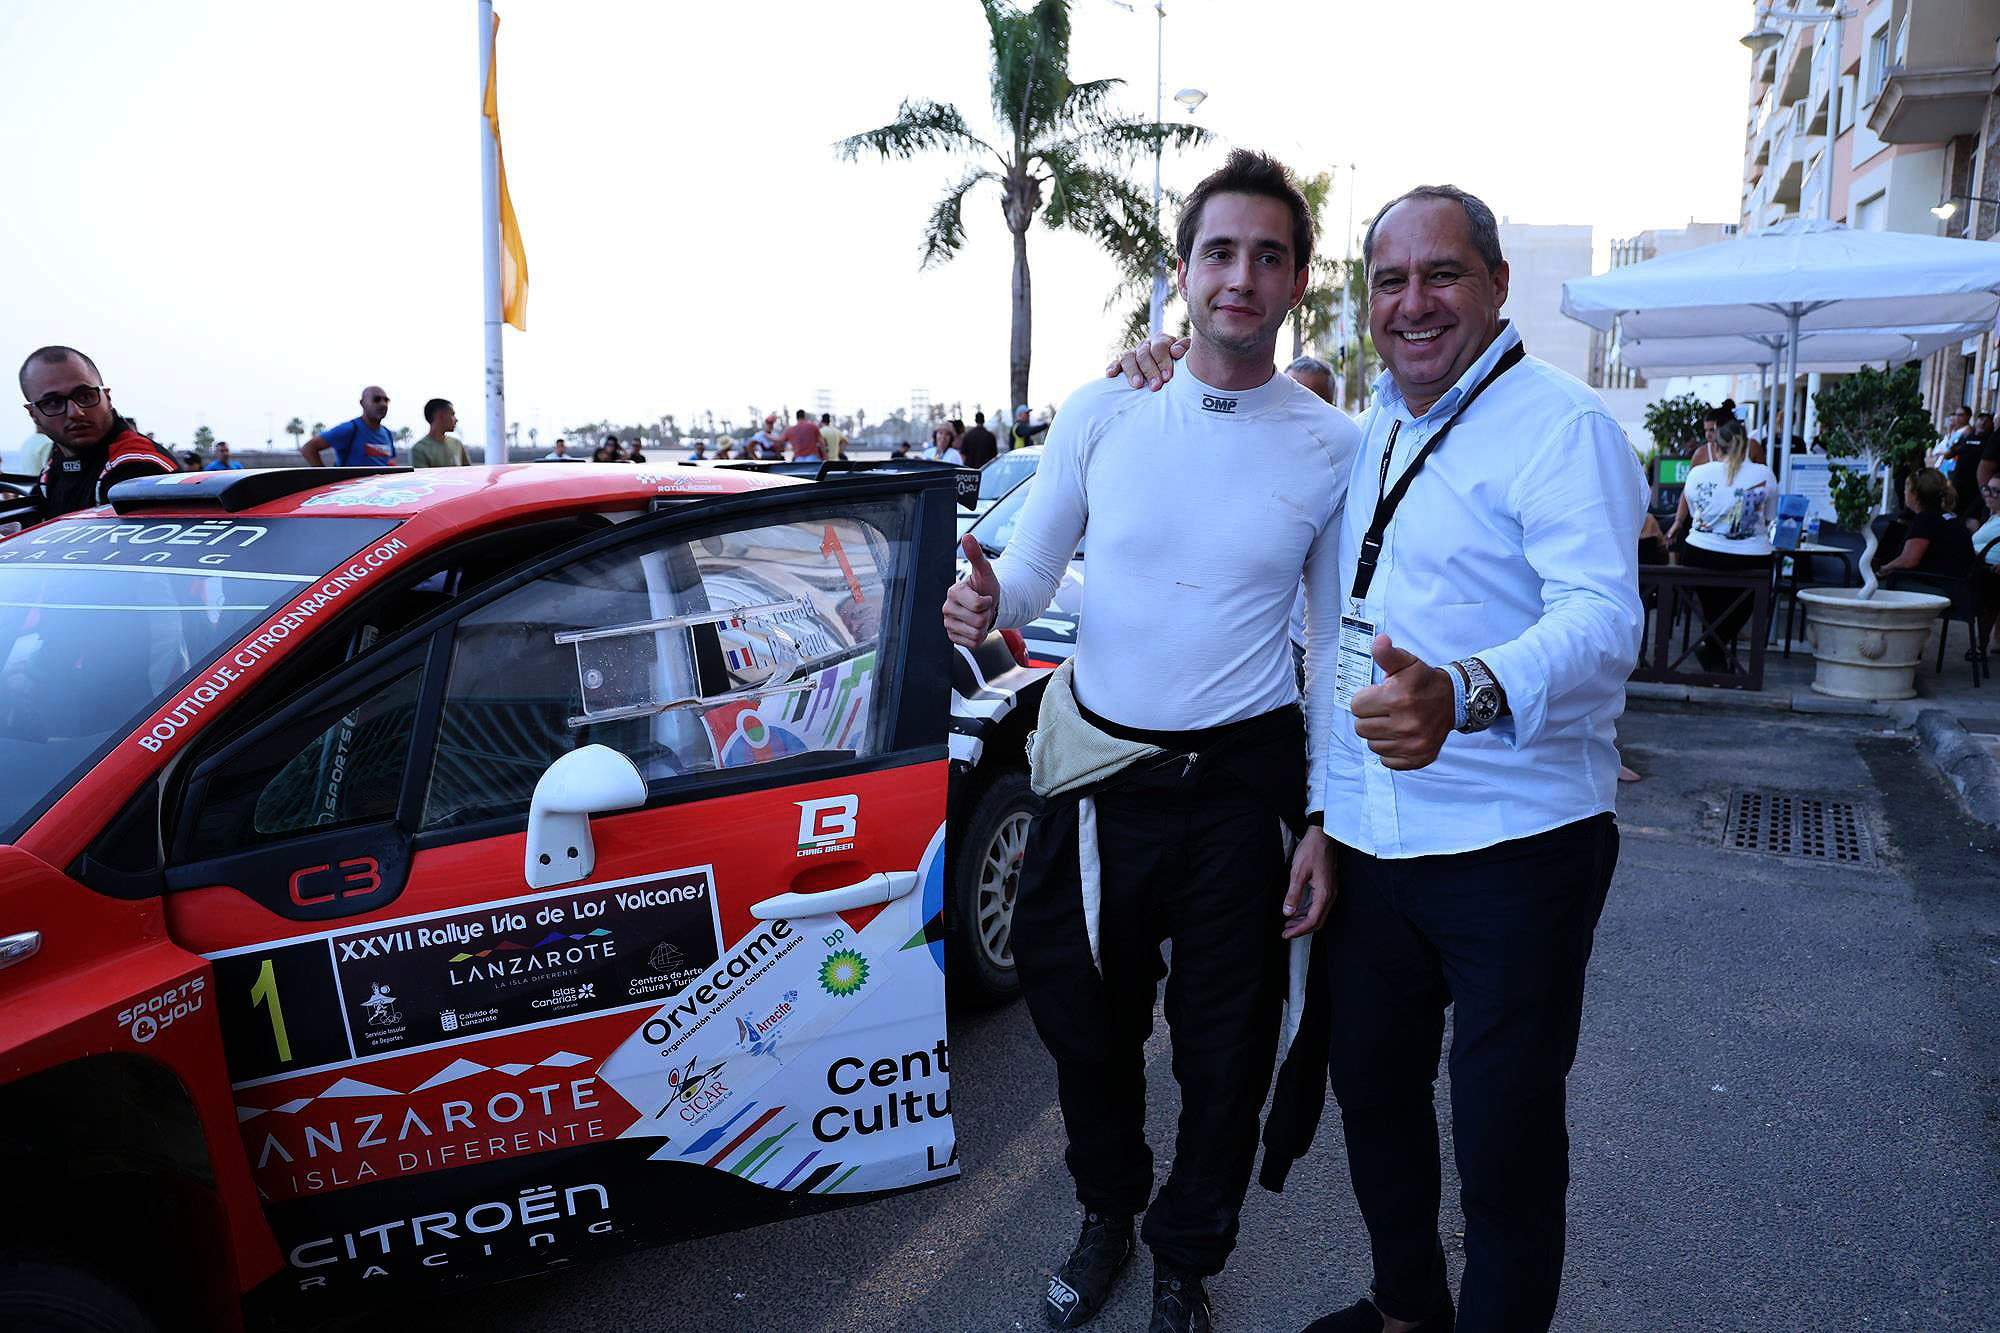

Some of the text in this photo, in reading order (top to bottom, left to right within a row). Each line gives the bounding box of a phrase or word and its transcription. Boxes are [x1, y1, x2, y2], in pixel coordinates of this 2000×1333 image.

[1203, 398, 1237, 410] OMP
[138, 537, 408, 753] BOUTIQUE.CITROENRACING.COM
[325, 727, 353, 812] SPORTS
[797, 842, 854, 858] CRAIG BREEN
[289, 857, 381, 907] C3
[339, 882, 705, 963] XXVII Rallye Isla de Los Volcanes
[822, 929, 844, 948] bp
[449, 941, 617, 986] LANZAROTE
[744, 959, 776, 987] Cabrera
[774, 935, 804, 961] Medina
[509, 978, 529, 986] ISLA
[531, 968, 579, 982] DIFERENTE
[628, 982, 665, 996] Cultura
[665, 982, 672, 991] y
[630, 967, 703, 987] Centros de Arte
[642, 918, 793, 1045] Orvecame
[117, 975, 205, 1028] SPORTS
[531, 994, 577, 1009] Canarias
[551, 987, 576, 998] Islas
[251, 959, 293, 1062] 1
[459, 1010, 488, 1021] Cabildo
[460, 1015, 498, 1027] Lanzarote
[756, 1001, 792, 1034] Arrecife
[364, 1025, 406, 1039] Servicio Insular
[371, 1034, 404, 1046] de Deportes
[680, 1081, 729, 1122] CICAR
[293, 1120, 604, 1193] ISLA DIFERENTE
